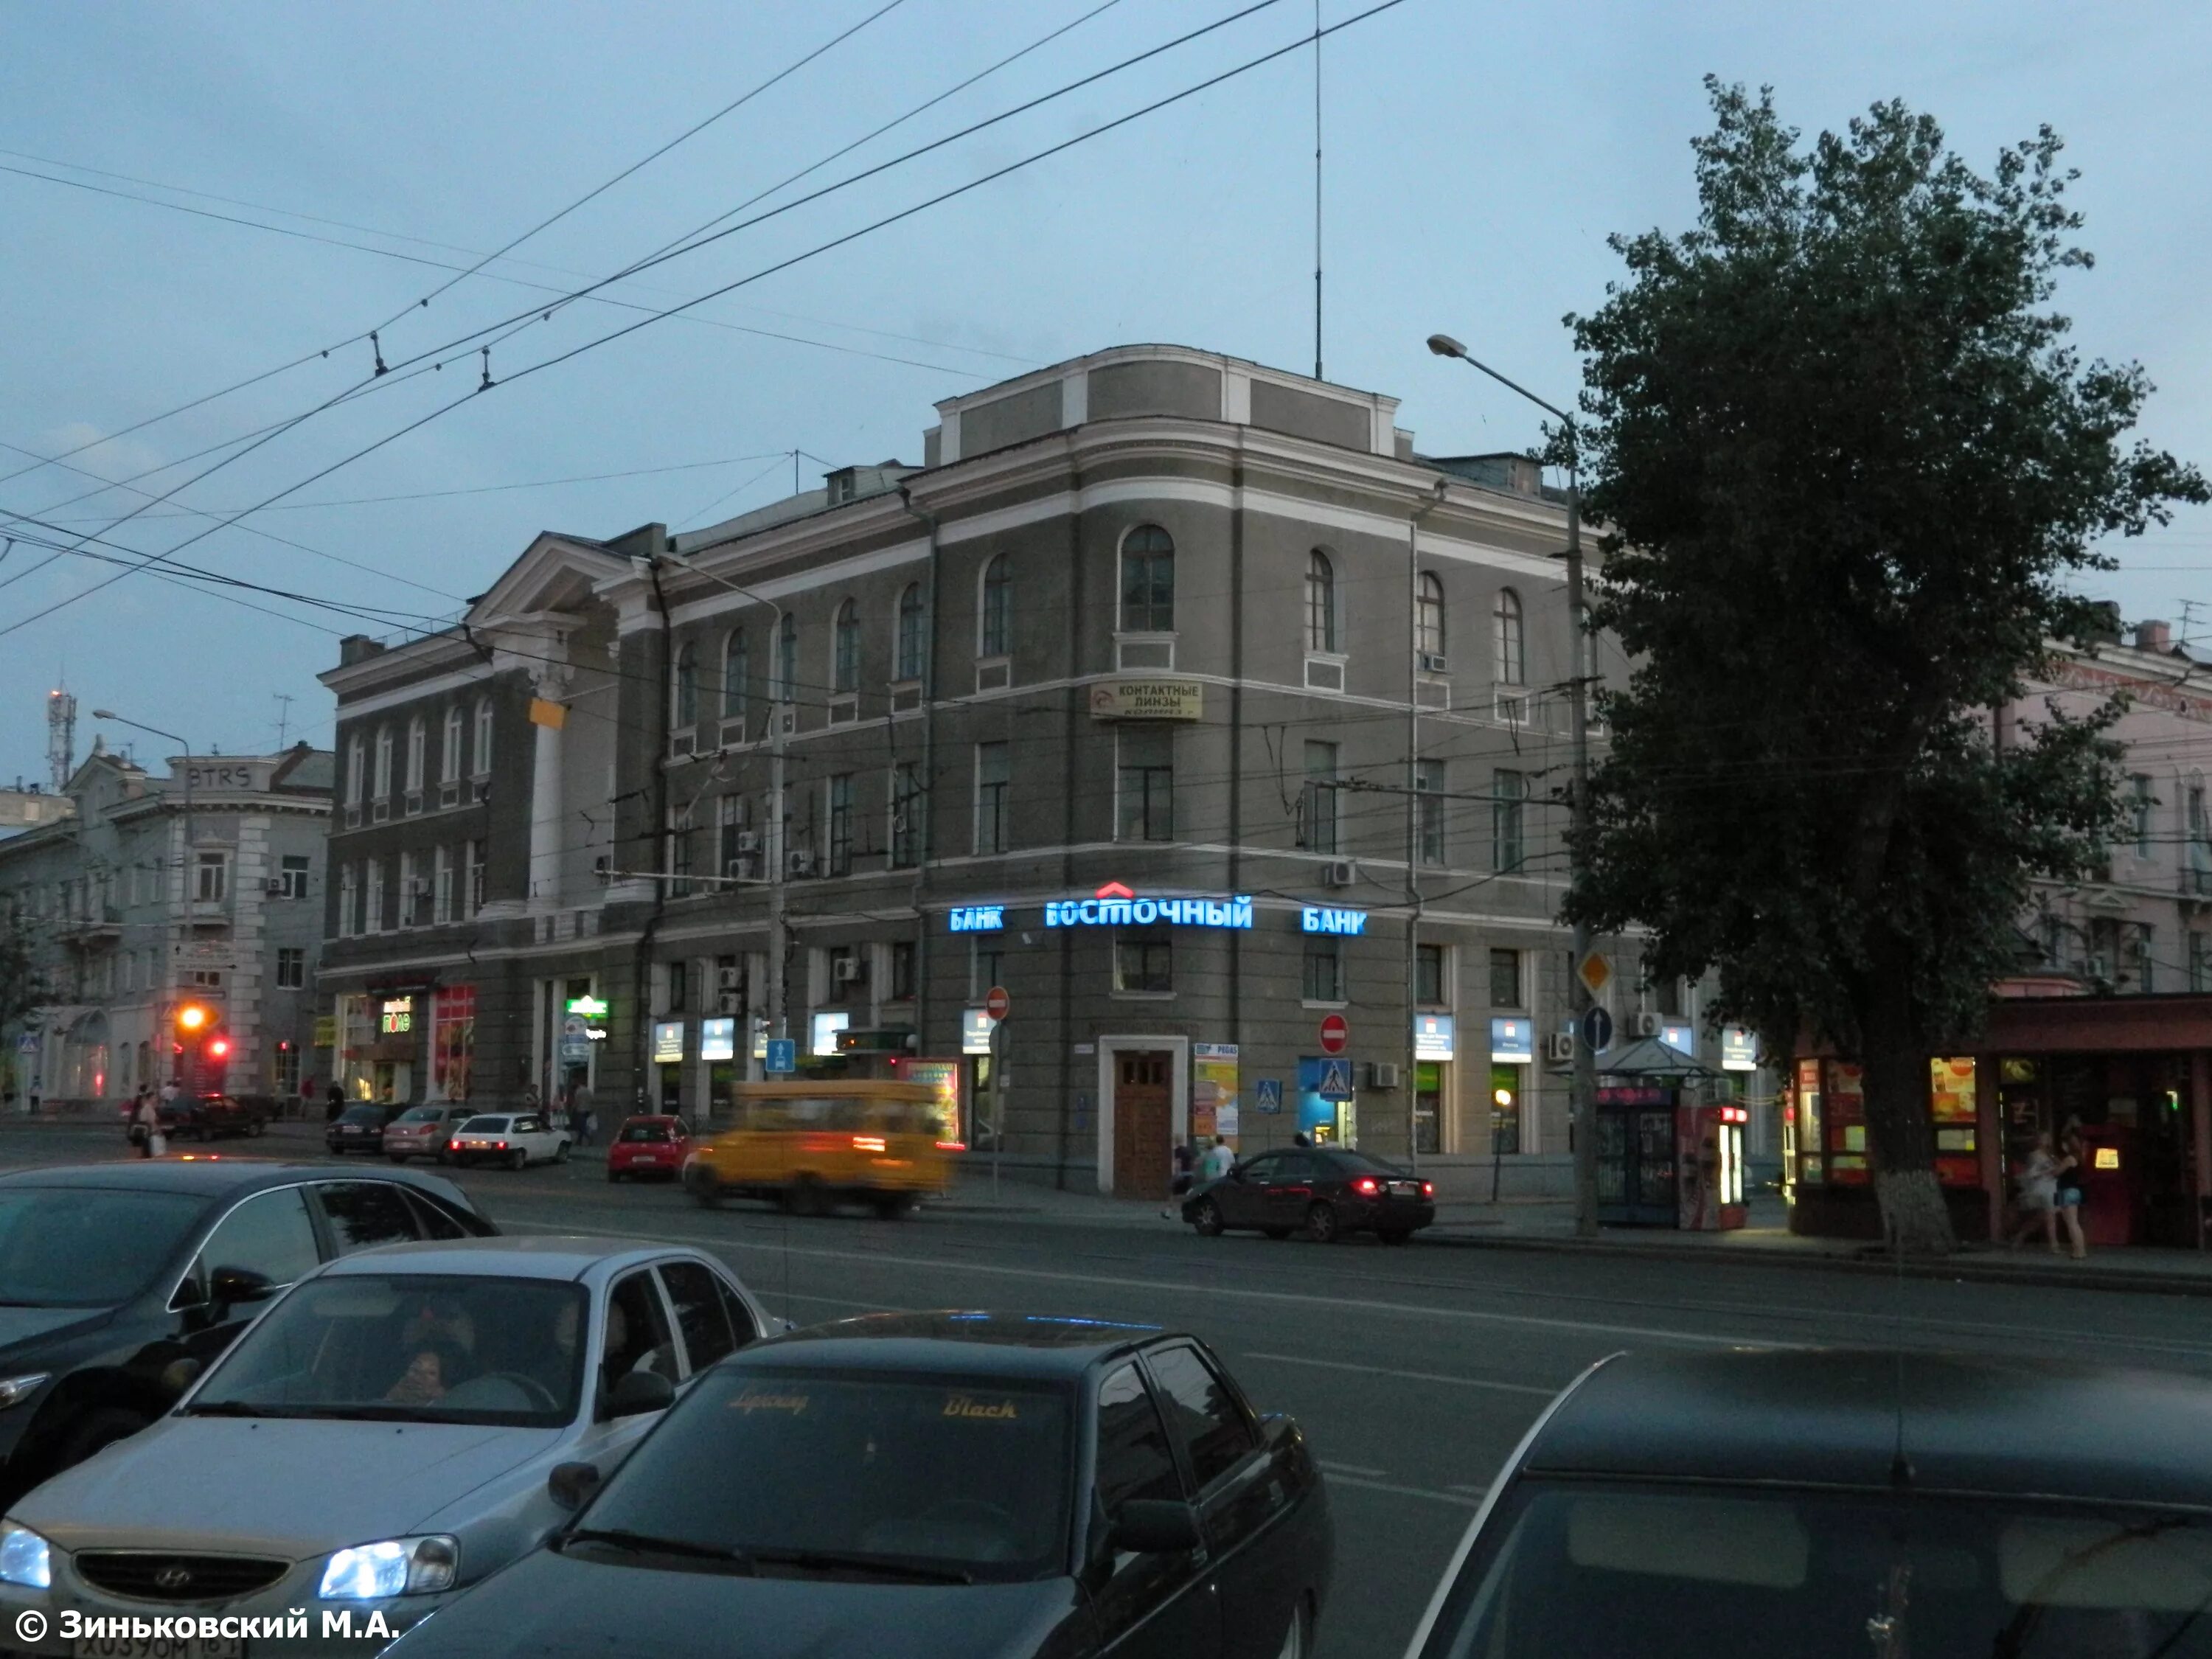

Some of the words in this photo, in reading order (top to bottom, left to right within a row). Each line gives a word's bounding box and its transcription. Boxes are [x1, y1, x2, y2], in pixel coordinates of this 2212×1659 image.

[1119, 685, 1199, 697] КОНТАКТНЫЕ
[1135, 697, 1180, 707] ЛИНЗЫ
[950, 905, 1004, 931] БАНК
[1302, 906, 1368, 935] БАНК
